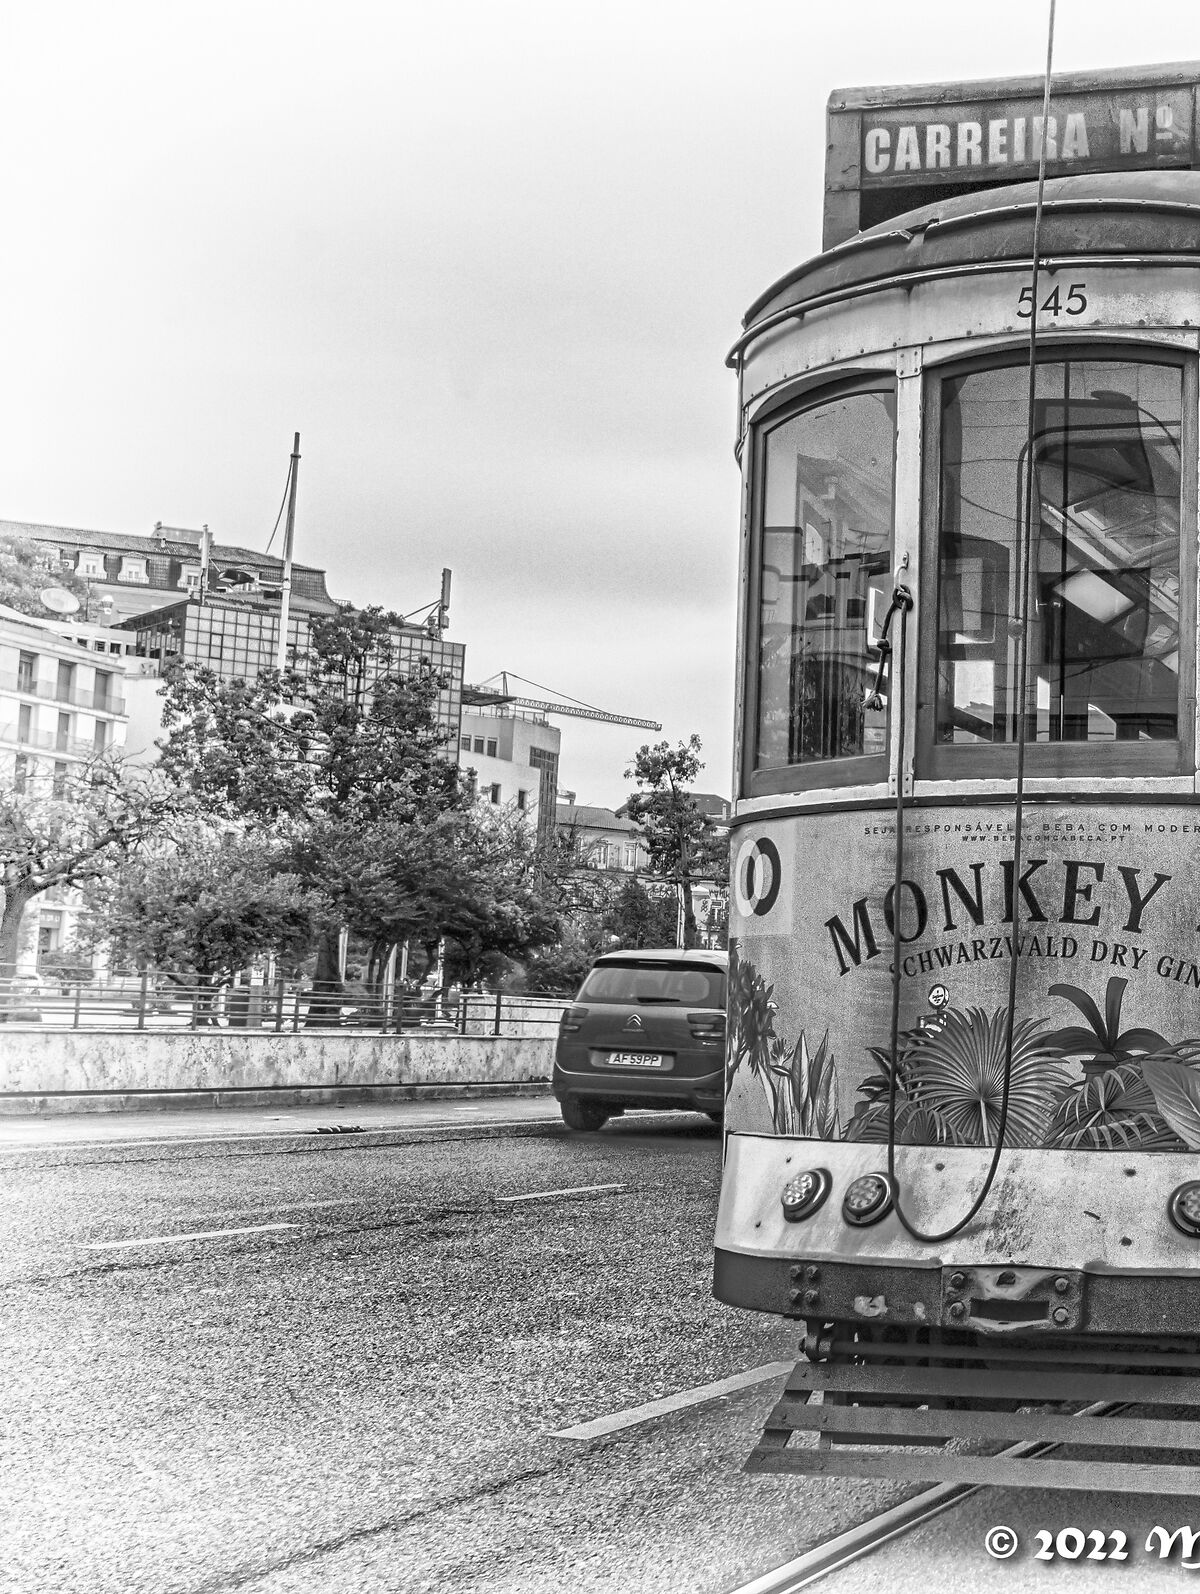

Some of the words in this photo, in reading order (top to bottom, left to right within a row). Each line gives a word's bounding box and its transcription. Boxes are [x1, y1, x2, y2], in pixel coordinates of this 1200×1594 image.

[864, 112, 1091, 174] CARREIRA
[1016, 283, 1088, 319] 545
[864, 826, 896, 835] SEJA
[1042, 823, 1085, 832] BEBA
[1098, 823, 1131, 832] COM
[824, 859, 1172, 977] MONKEY
[1090, 939, 1149, 970] DRY
